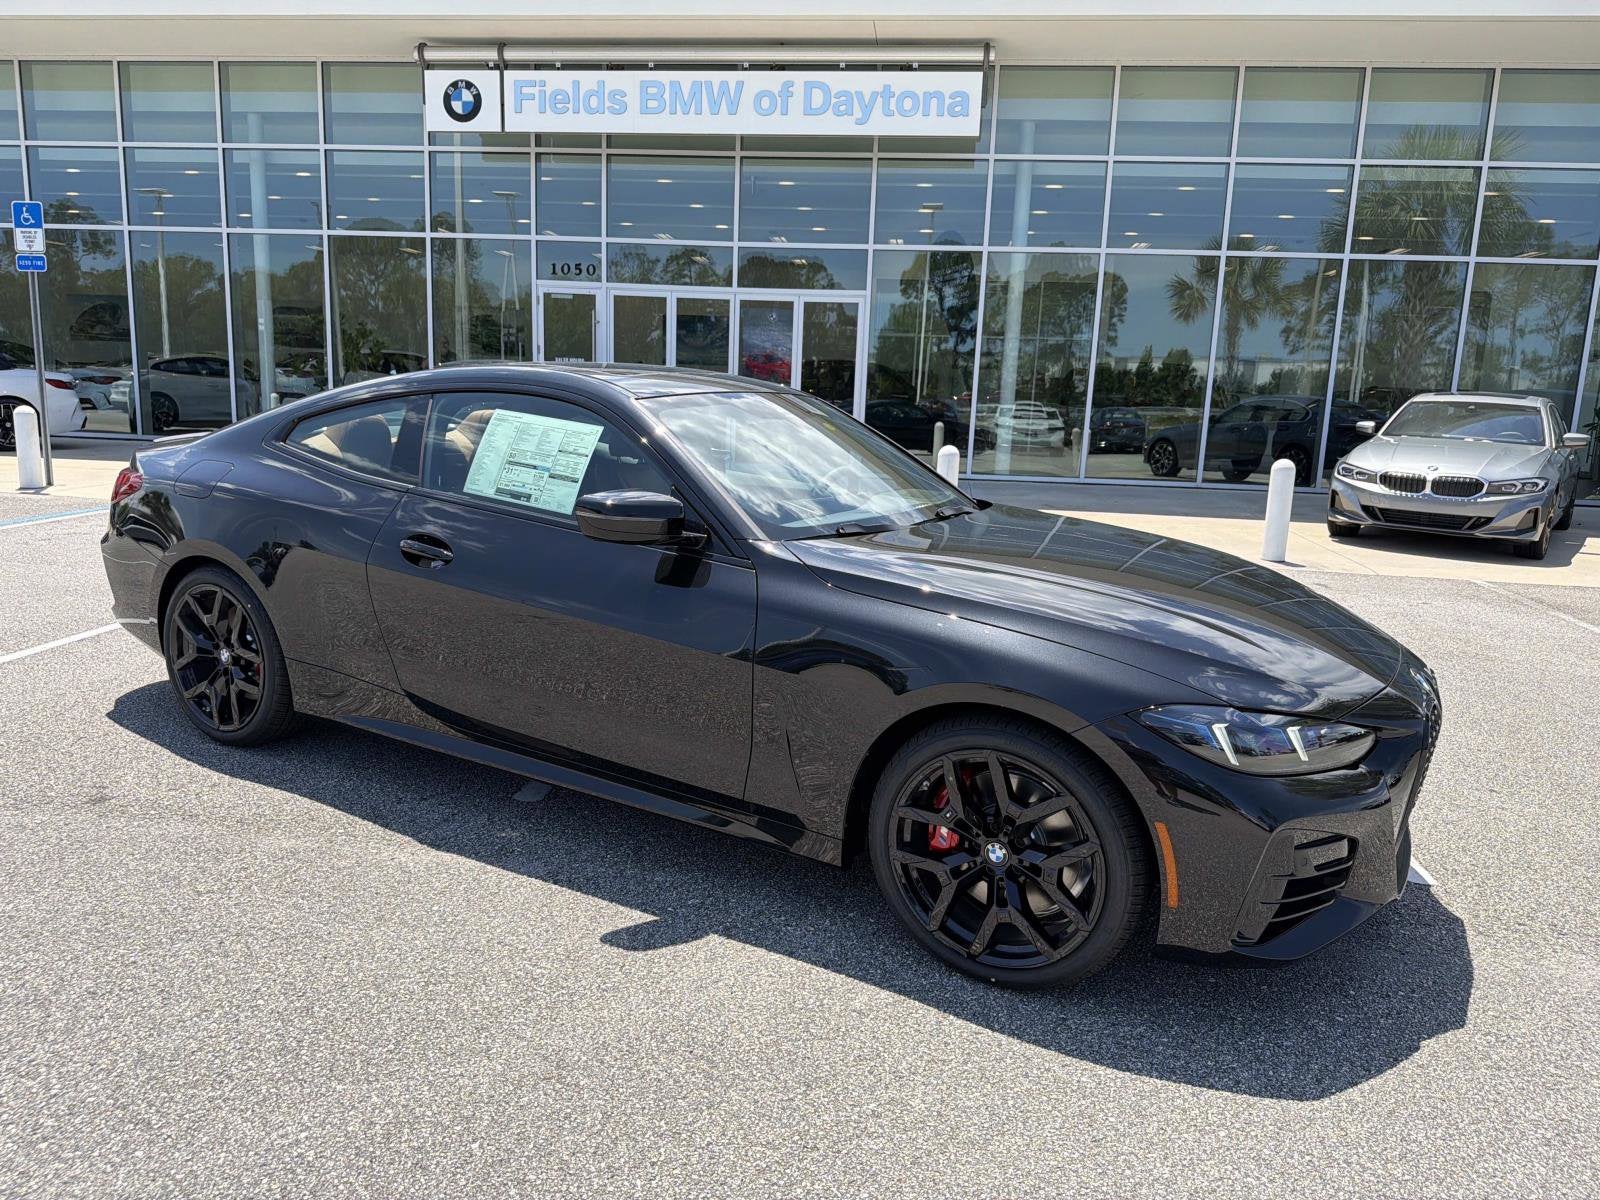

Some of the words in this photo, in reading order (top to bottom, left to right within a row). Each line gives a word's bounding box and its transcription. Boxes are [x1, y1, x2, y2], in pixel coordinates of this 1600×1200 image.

[447, 81, 479, 96] BMW
[513, 80, 628, 115] Fields
[639, 80, 744, 116] BMW
[753, 80, 795, 117] of
[802, 80, 970, 126] Daytona
[551, 262, 597, 276] 1050
